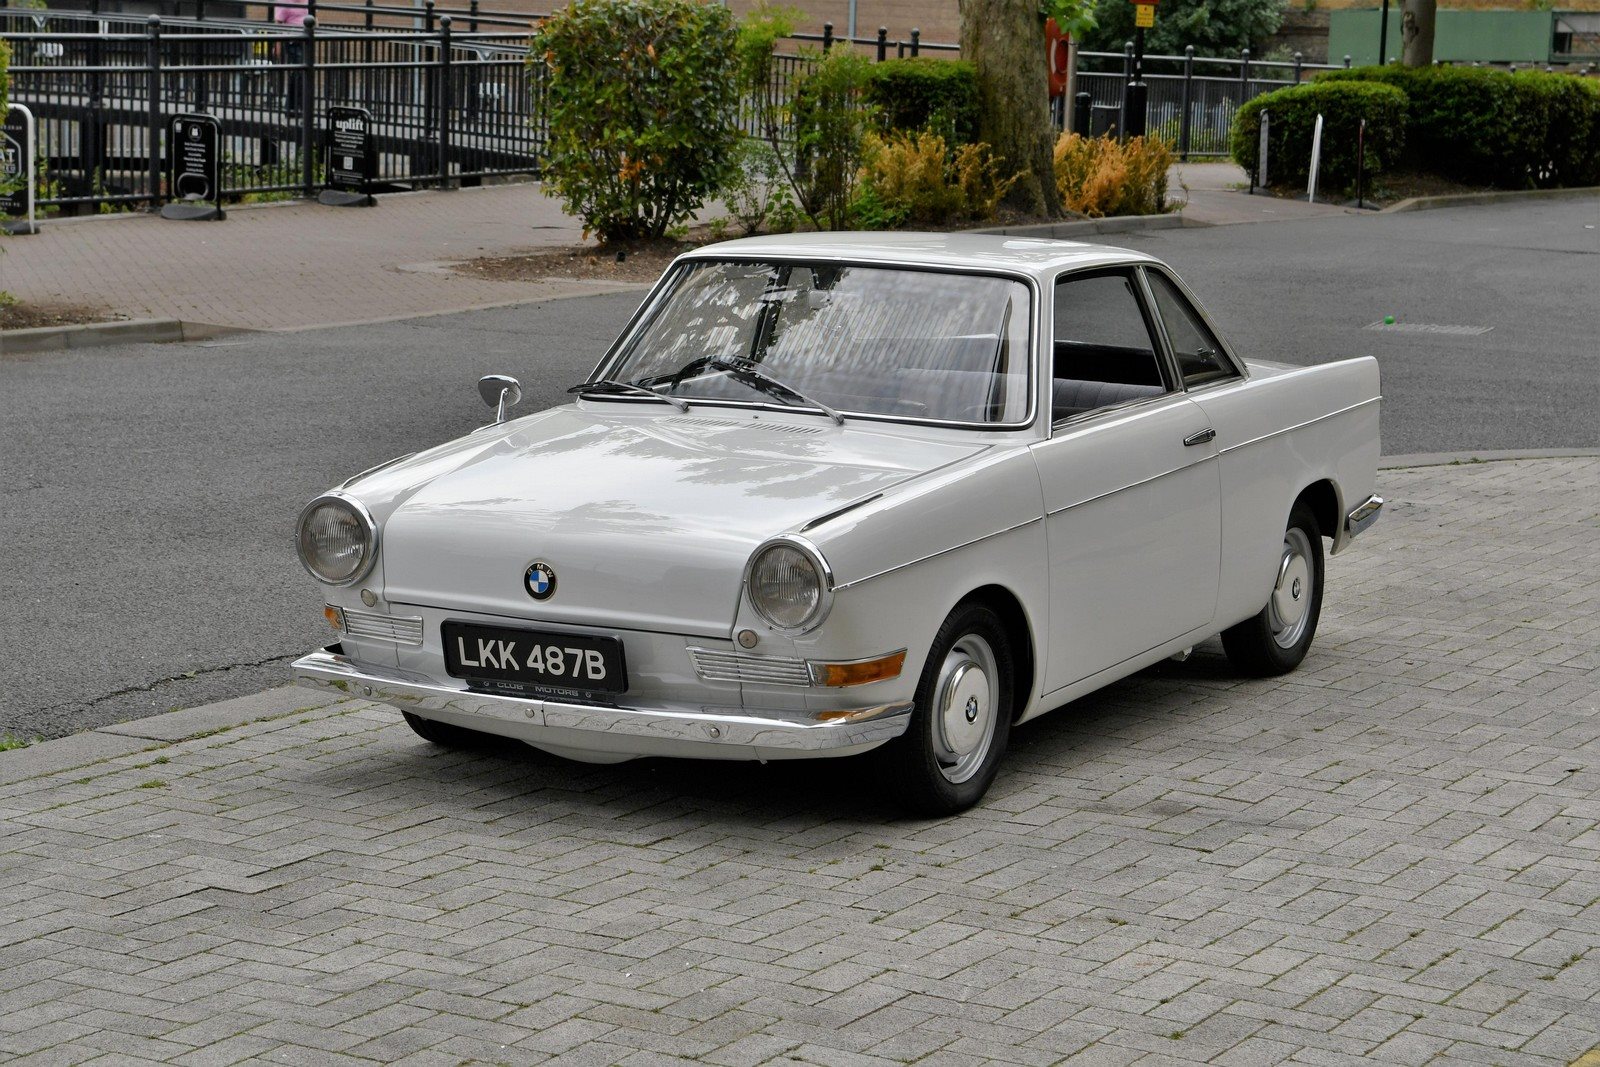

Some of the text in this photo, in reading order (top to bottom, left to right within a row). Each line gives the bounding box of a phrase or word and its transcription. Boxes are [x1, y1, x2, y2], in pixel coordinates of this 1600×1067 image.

[335, 118, 364, 132] uplift
[457, 636, 607, 680] LKK 487B
[497, 682, 579, 697] CLUB MOTORS
